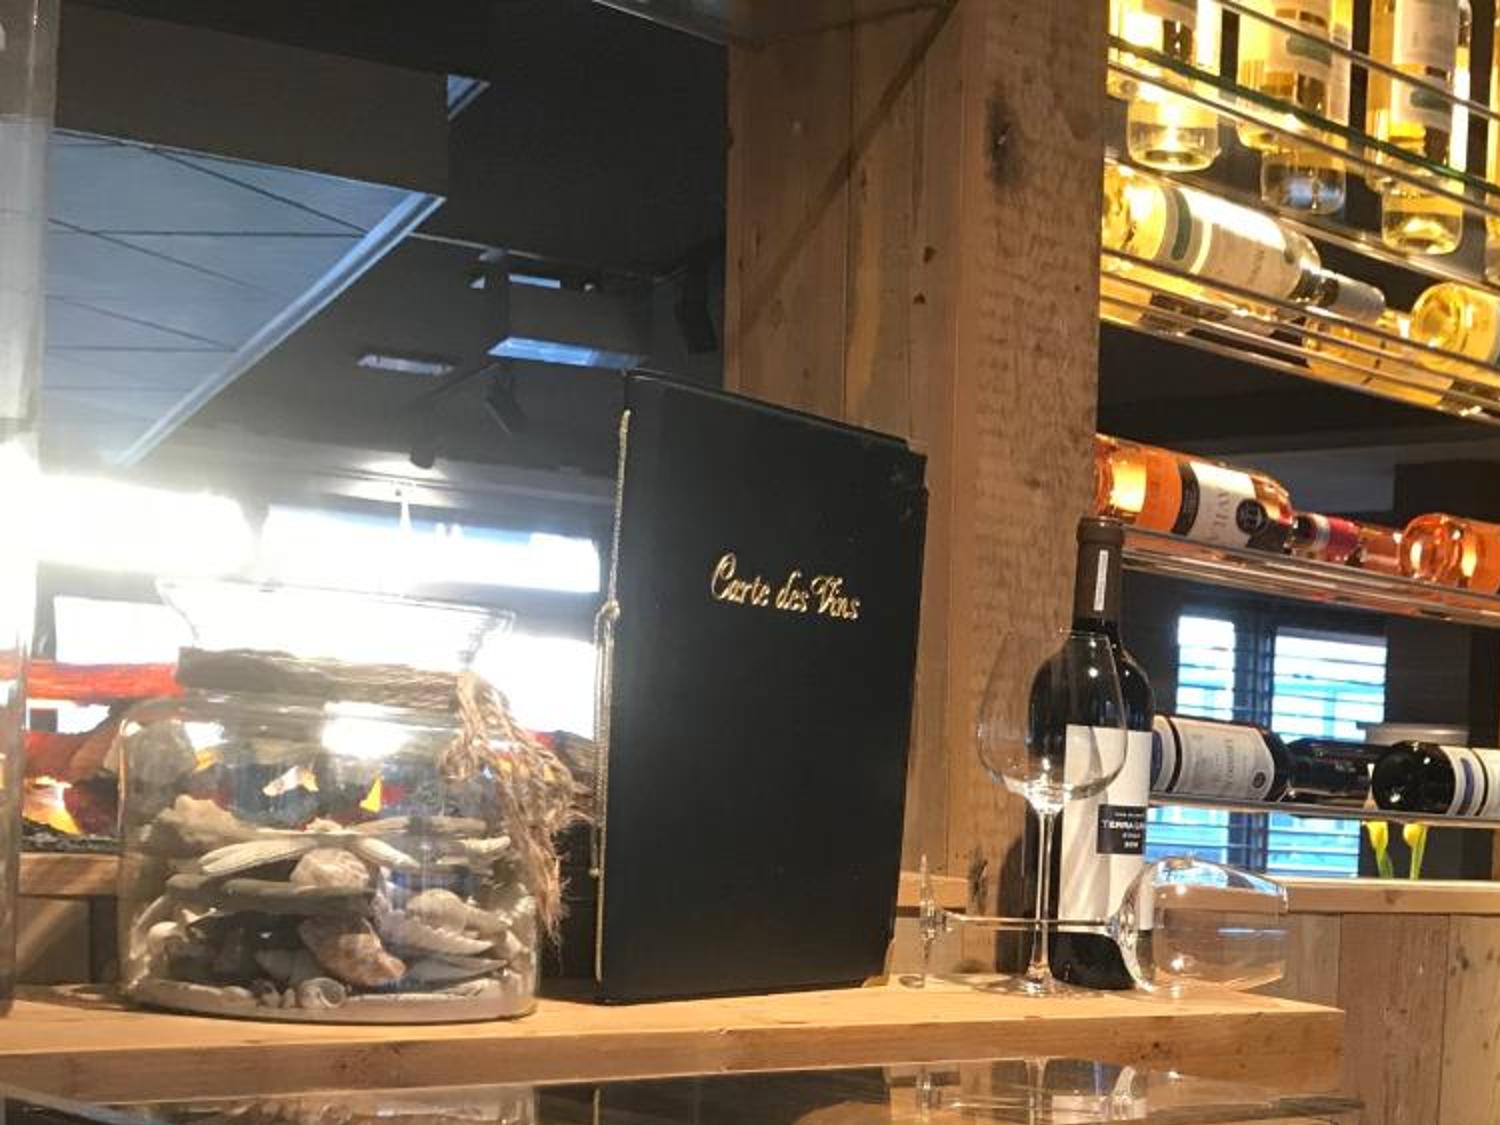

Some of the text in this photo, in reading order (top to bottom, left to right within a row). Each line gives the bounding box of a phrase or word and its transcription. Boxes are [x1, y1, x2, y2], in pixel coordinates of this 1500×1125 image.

[711, 552, 861, 620] Carte des Vins
